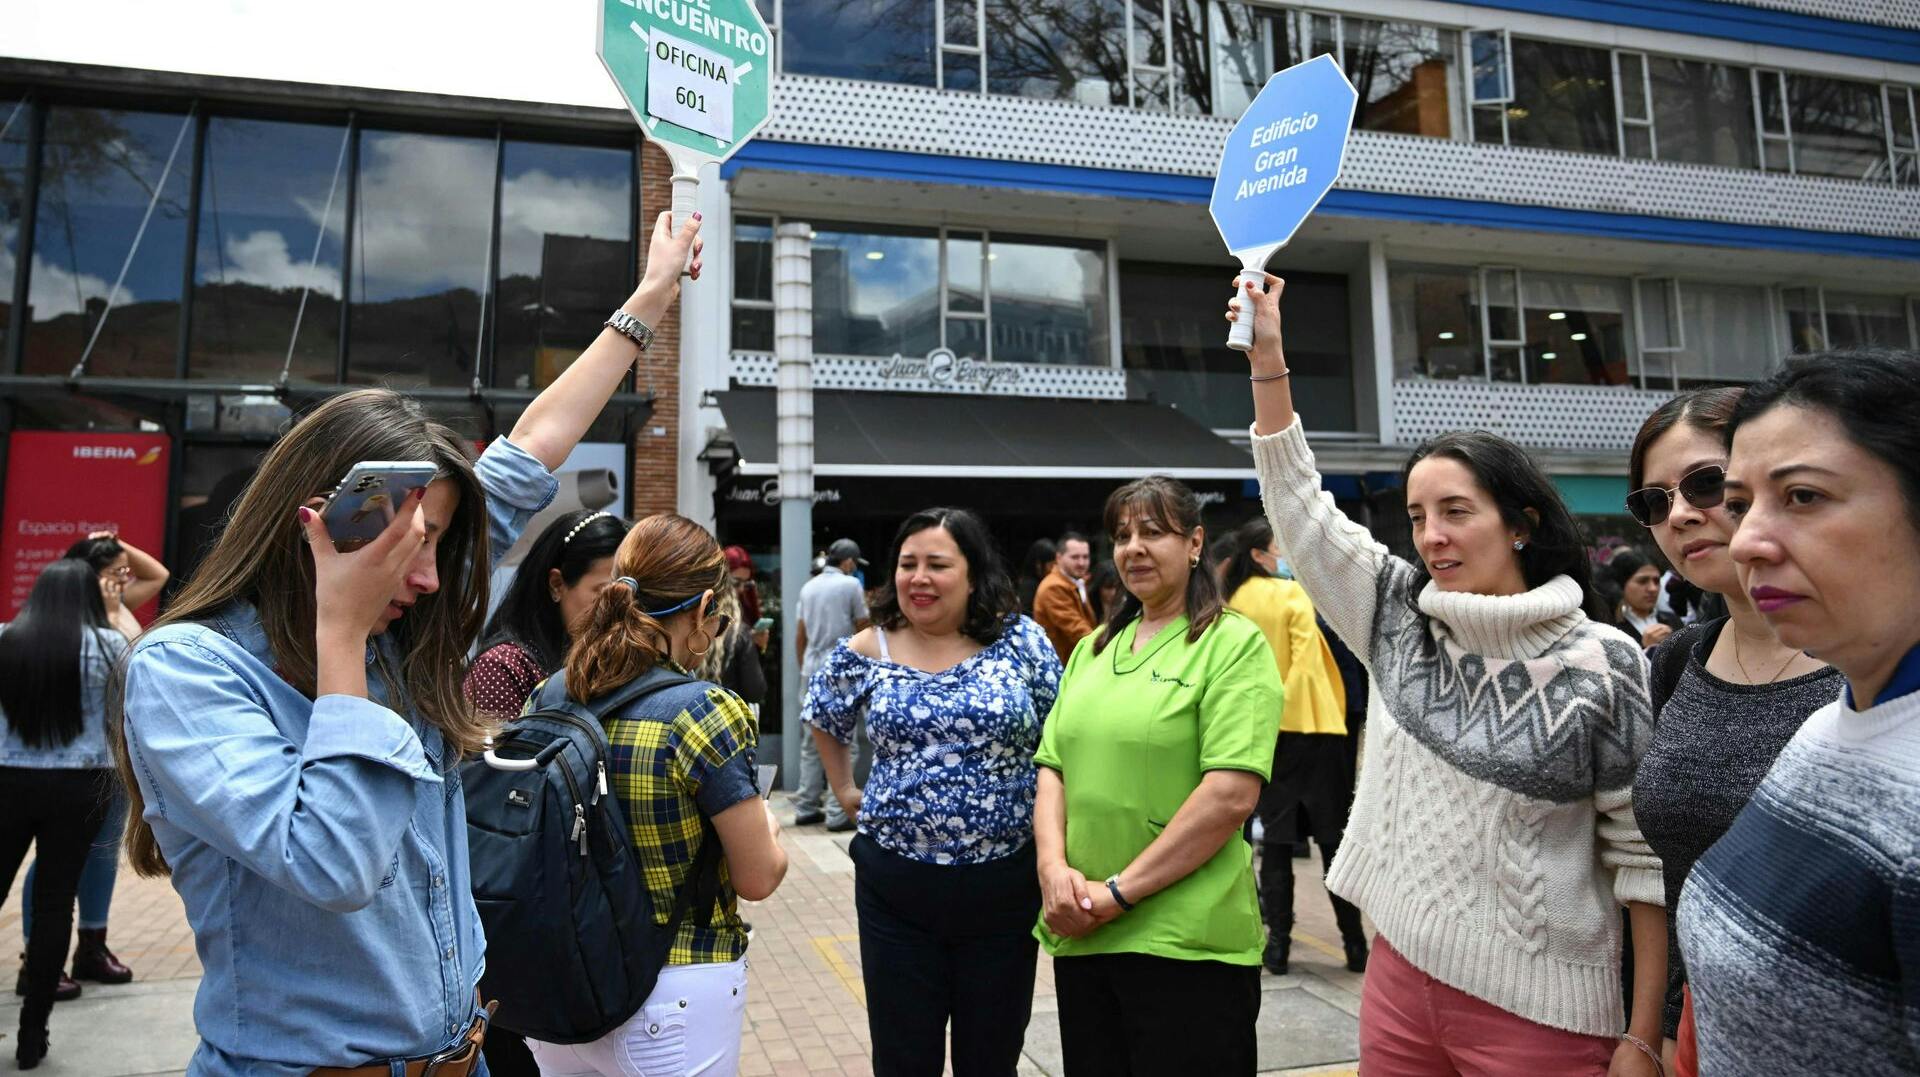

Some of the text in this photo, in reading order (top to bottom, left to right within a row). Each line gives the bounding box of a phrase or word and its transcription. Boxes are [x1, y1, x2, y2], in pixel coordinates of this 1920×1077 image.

[656, 41, 728, 84] OFICINA
[676, 87, 707, 113] 601
[1250, 111, 1319, 148] Edificio
[1254, 146, 1298, 172] Gran
[1235, 165, 1308, 201] Avenida
[879, 352, 1021, 393] Juan Burgers
[73, 446, 136, 459] IBERIA
[725, 485, 761, 501] Juan
[19, 520, 76, 535] Espacio
